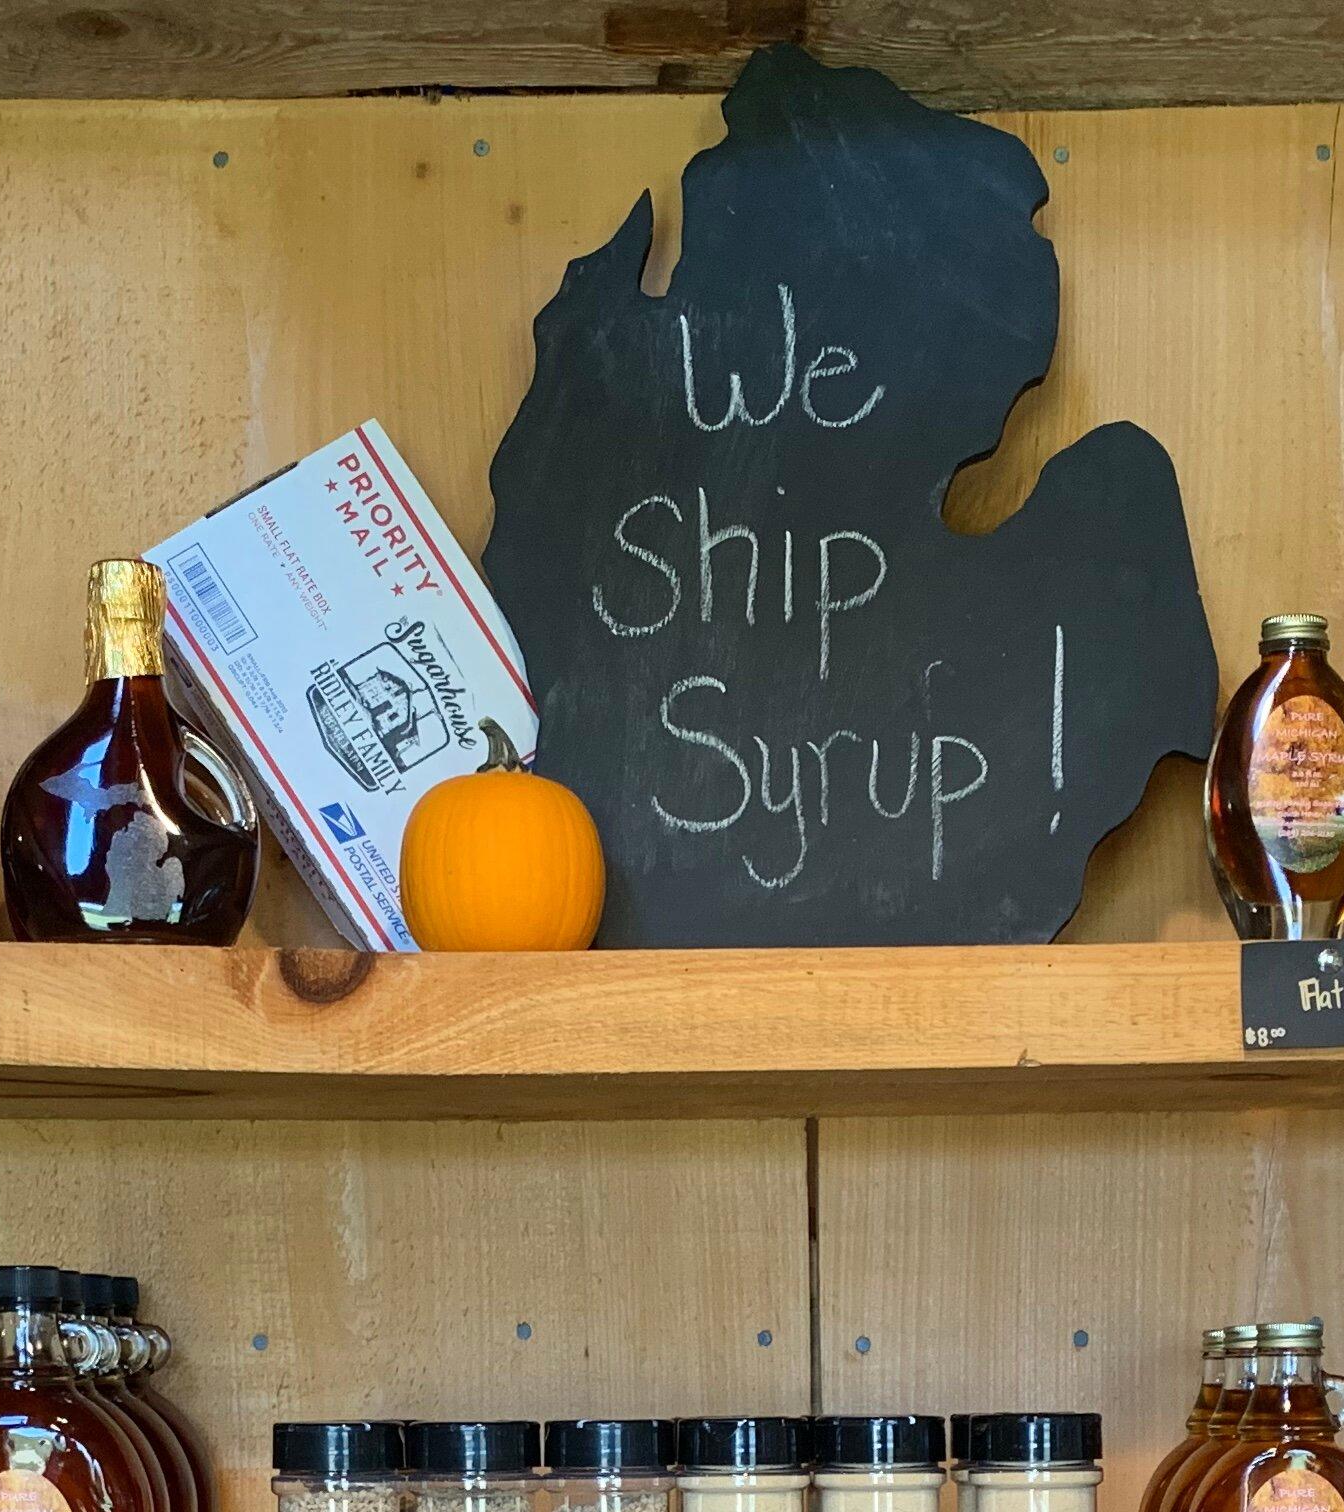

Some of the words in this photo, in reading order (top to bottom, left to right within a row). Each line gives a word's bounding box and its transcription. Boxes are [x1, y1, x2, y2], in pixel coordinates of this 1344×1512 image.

[680, 282, 885, 432] We
[257, 505, 282, 541] SMALL
[280, 539, 300, 566] FLAT
[297, 565, 318, 593] RATE
[313, 592, 331, 614] BOX
[336, 501, 388, 578] MAIL
[337, 452, 440, 592] PRIORITY
[593, 485, 887, 680] Ship
[310, 662, 363, 726] RIDLEY
[351, 728, 406, 795] FAMILY
[385, 620, 477, 750] Sugarhouse
[344, 846, 377, 892] POSTAL
[362, 839, 396, 885] UNITED
[1299, 977, 1344, 1011] Flat
